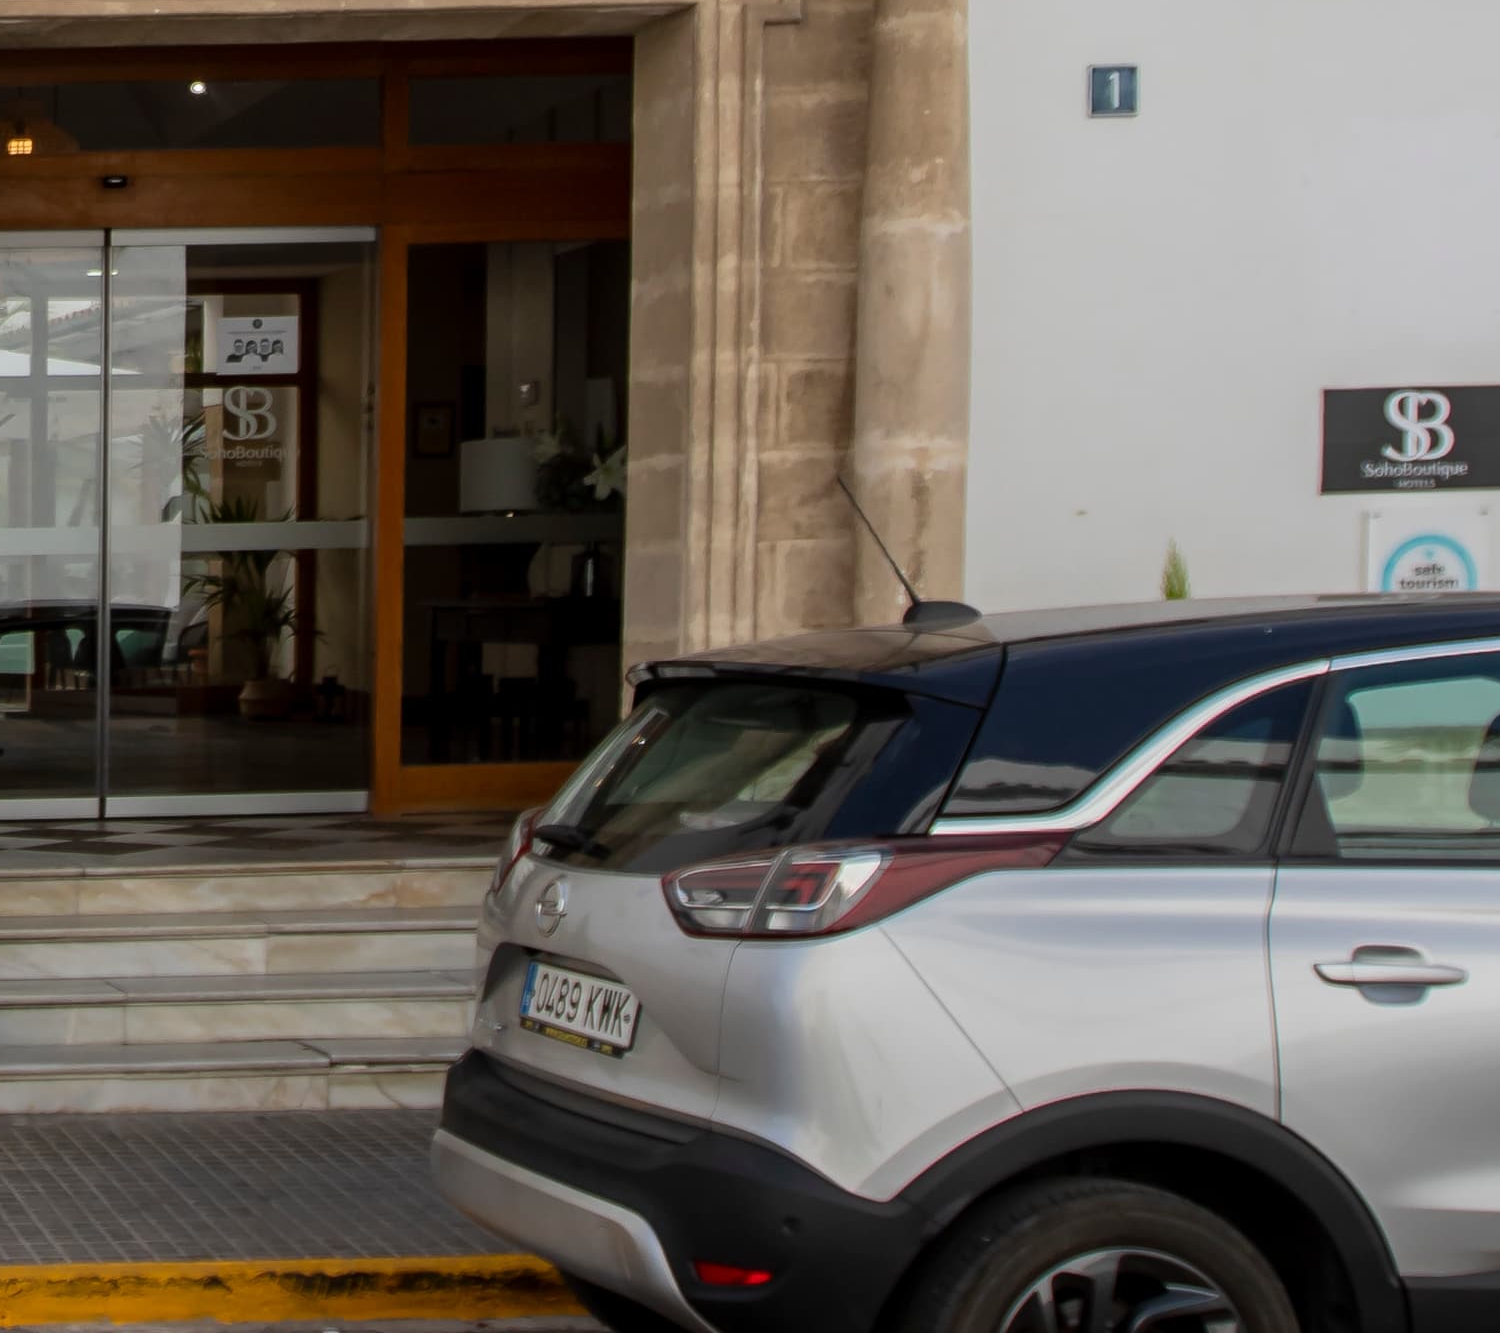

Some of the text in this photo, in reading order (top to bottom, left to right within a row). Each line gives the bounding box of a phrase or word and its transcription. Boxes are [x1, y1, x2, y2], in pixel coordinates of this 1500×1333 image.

[1360, 461, 1469, 480] SohoBoutique
[1399, 577, 1459, 590] tourism
[535, 973, 582, 1023] 0489
